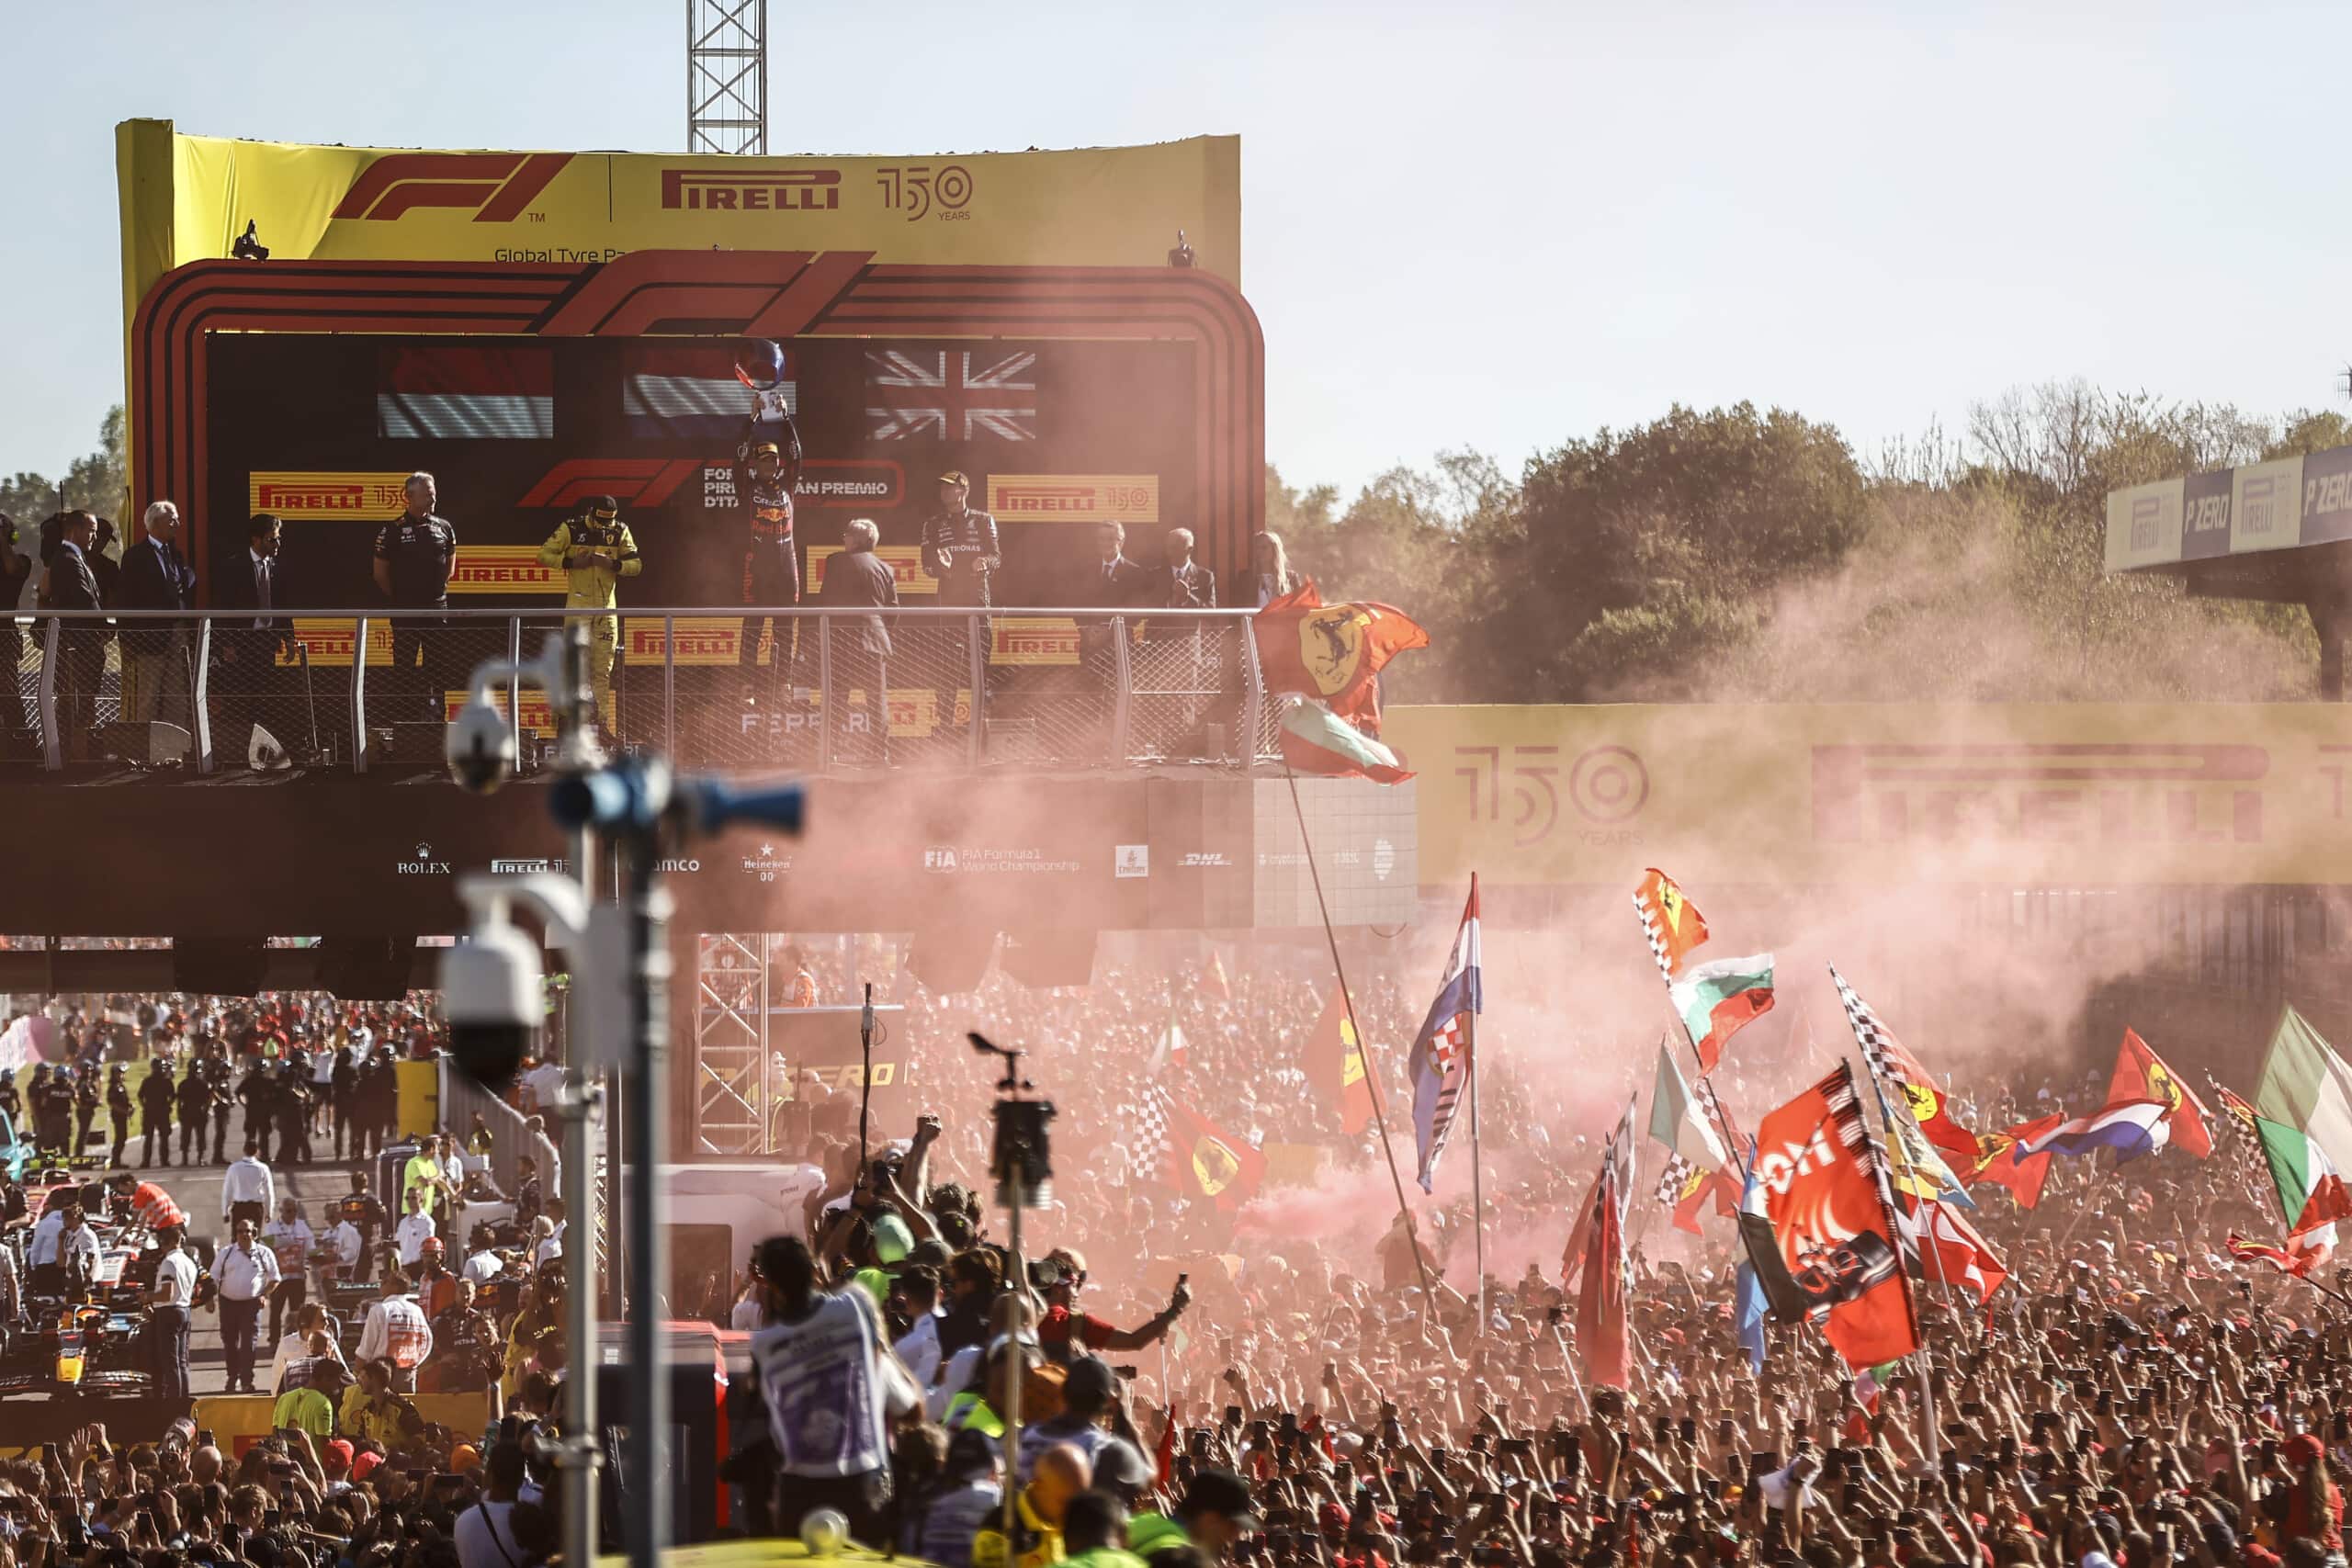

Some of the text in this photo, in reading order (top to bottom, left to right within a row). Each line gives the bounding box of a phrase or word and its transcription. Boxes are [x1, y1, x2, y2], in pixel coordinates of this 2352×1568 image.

[661, 169, 842, 209] PIRELLI
[876, 165, 973, 221] 150
[528, 213, 546, 222] TM
[938, 212, 971, 221] YEARS
[494, 248, 551, 264] Global
[558, 249, 599, 264] Tyre
[259, 485, 364, 508] PIRELLI
[822, 483, 888, 494] PREMIO
[996, 487, 1096, 511] PIRELLI
[2304, 479, 2316, 517] P
[2185, 499, 2194, 536] P
[2195, 492, 2231, 533] ZERO
[741, 713, 871, 733] FERRRI
[1454, 745, 1650, 848] 150
[1811, 744, 2270, 842] PIRELLI
[1578, 832, 1644, 846] YEARS
[984, 848, 1033, 860] Formula
[397, 863, 451, 874] ROLEX
[492, 860, 548, 873] PIRELLI
[999, 862, 1082, 874] Championship
